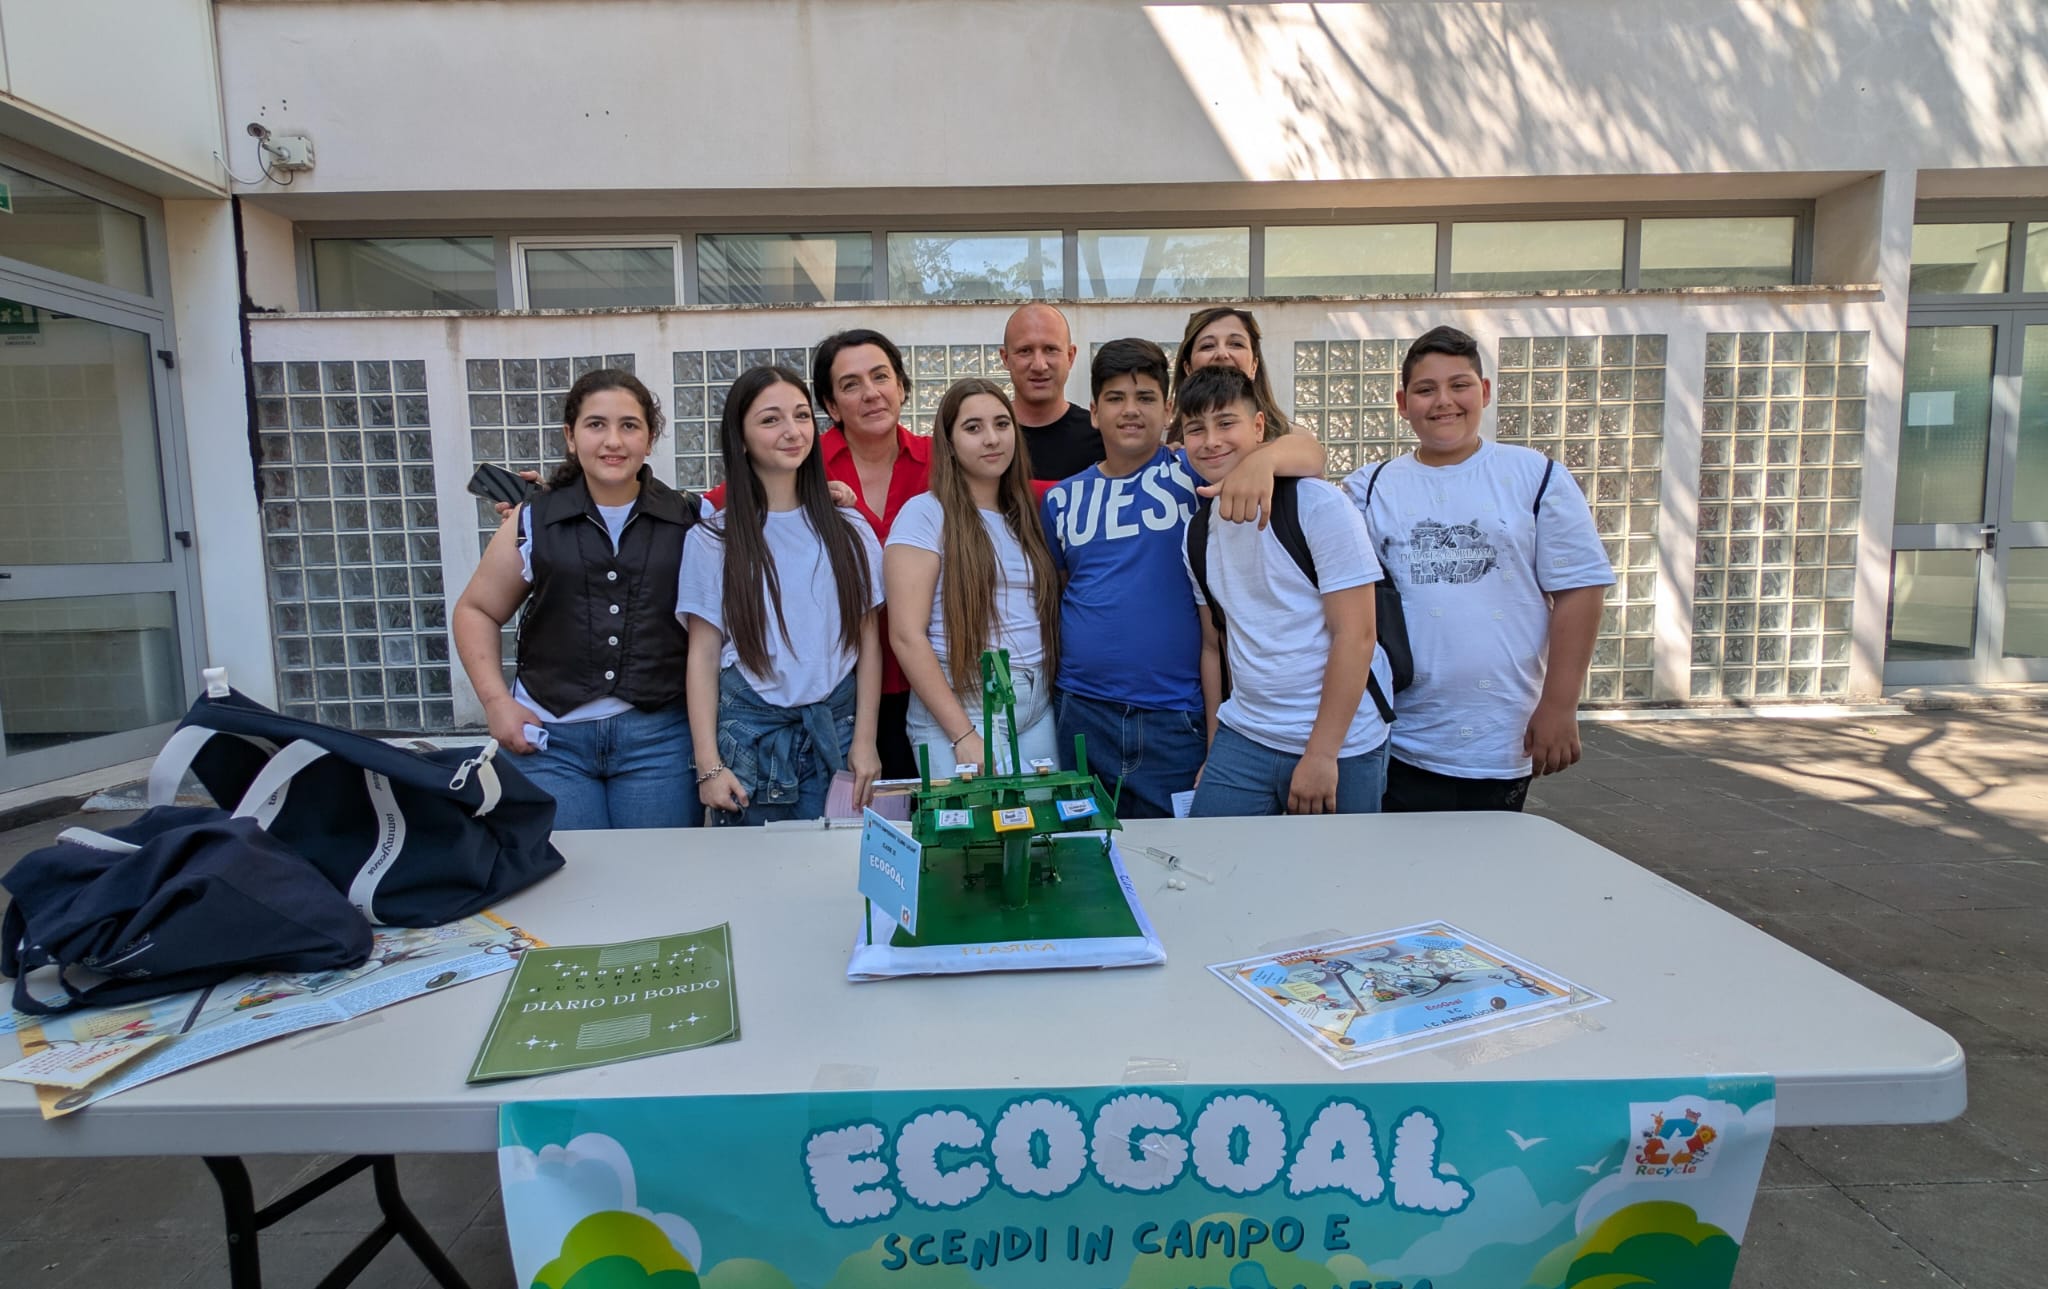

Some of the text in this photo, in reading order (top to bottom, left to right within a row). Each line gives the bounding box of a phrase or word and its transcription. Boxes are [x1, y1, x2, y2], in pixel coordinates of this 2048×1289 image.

[1047, 455, 1200, 551] GUESS
[869, 854, 905, 891] ECOGOAL
[562, 957, 694, 977] PROGETTO
[521, 979, 720, 1014] DIARIO DI BORDO
[805, 1091, 1473, 1226] ECOGOAL
[1635, 1163, 1697, 1177] Recycle
[882, 1213, 1351, 1271] SCENDI IN CAMPO E
